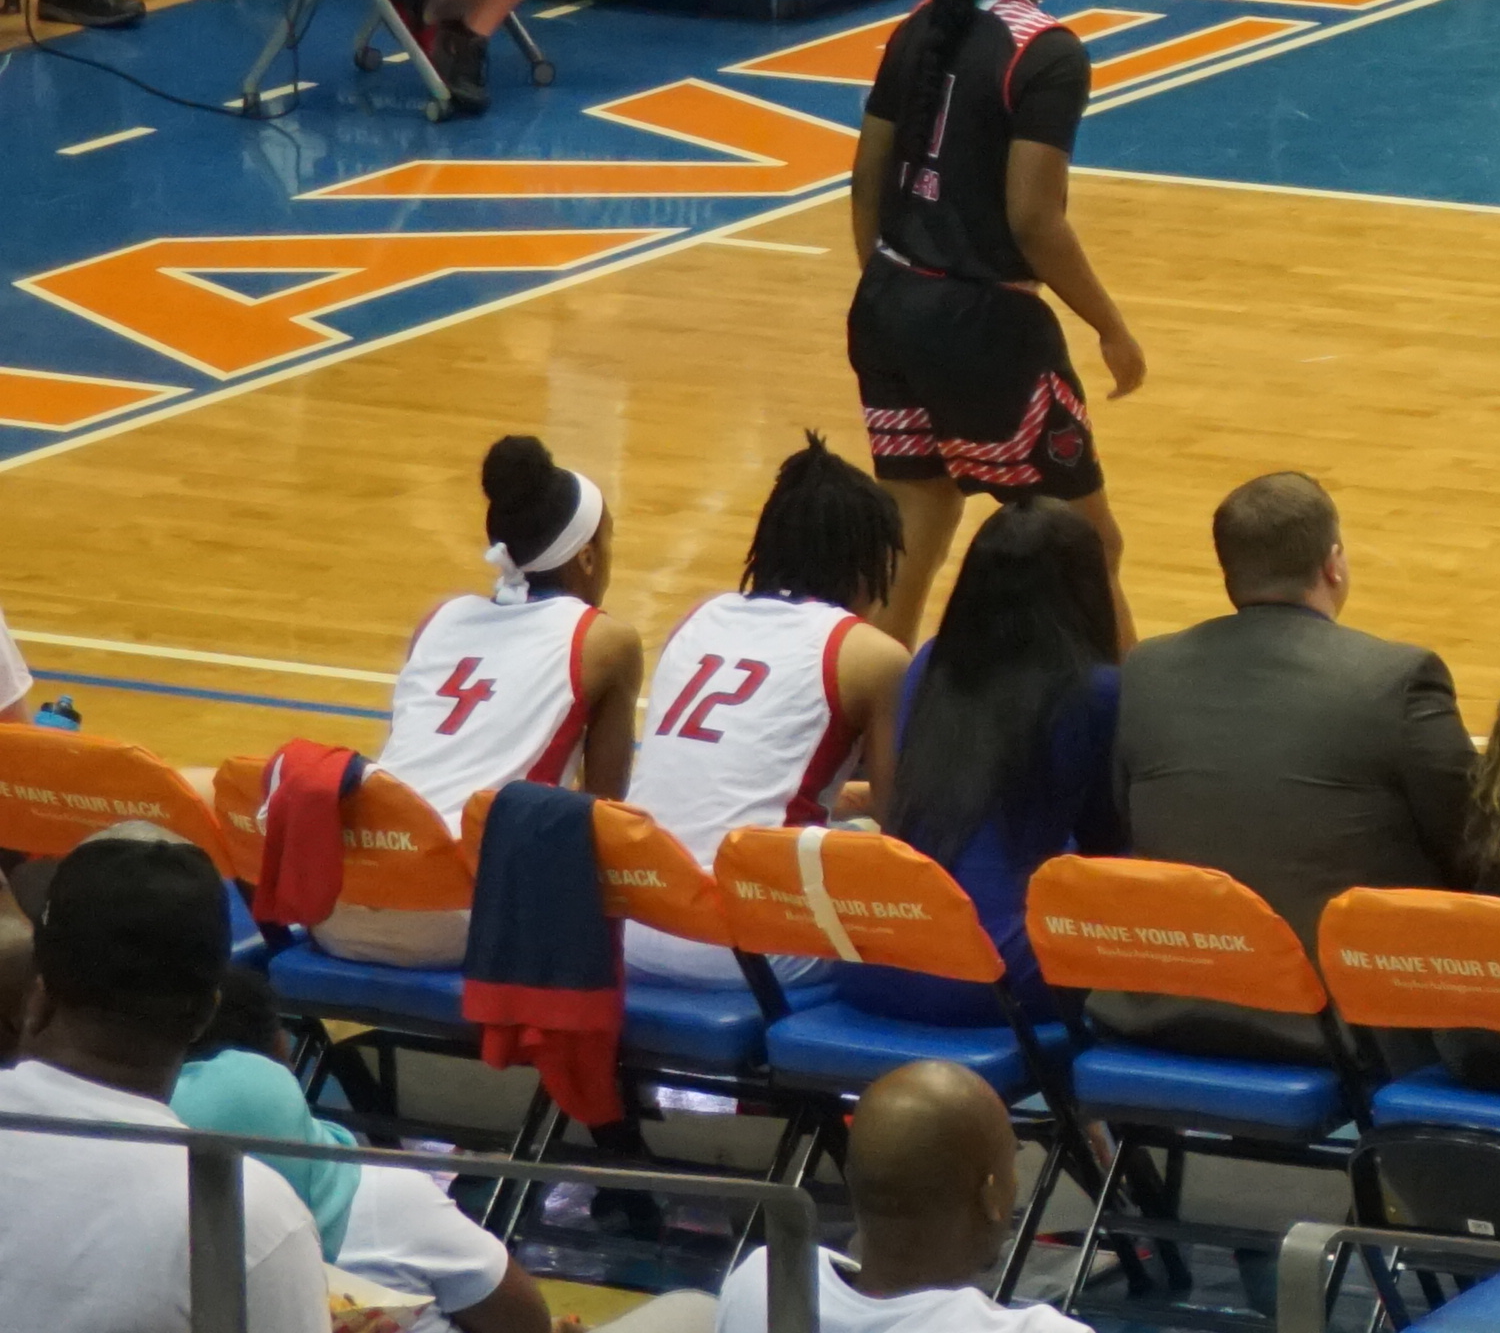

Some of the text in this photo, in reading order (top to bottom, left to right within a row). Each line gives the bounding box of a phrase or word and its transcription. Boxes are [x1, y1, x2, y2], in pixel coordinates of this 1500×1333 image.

[435, 656, 497, 735] 4
[654, 653, 770, 743] 12
[15, 785, 59, 806] HAVE
[61, 793, 109, 813] YOUR
[113, 799, 171, 819] BACK.
[228, 811, 257, 833] WE
[360, 828, 419, 852] BACK.
[735, 880, 767, 900] WE
[872, 902, 933, 921] BACK.
[1045, 915, 1256, 953] WE HAVE YOUR BACK.
[1340, 948, 1373, 970] WE
[1374, 954, 1428, 974] HAVE
[1430, 957, 1485, 978] YOUR
